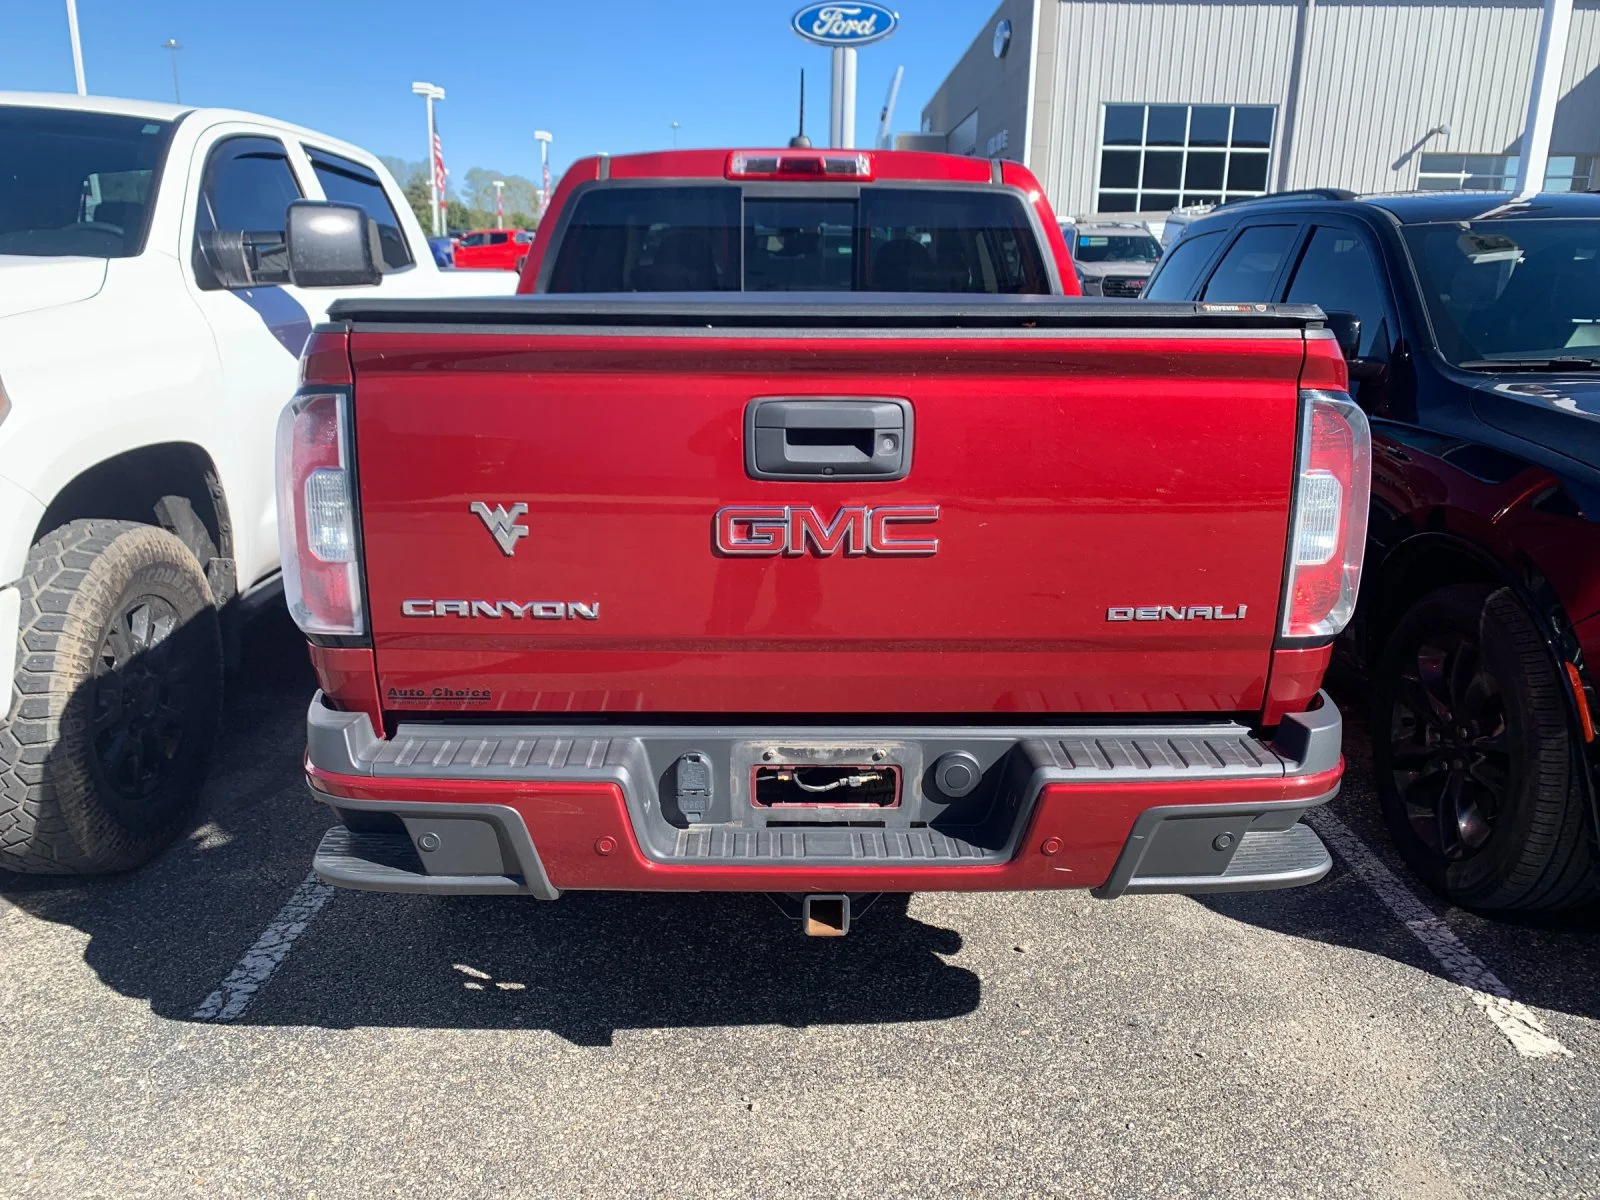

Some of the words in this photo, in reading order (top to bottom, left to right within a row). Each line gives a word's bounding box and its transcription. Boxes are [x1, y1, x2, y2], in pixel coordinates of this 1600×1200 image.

[812, 7, 877, 35] Ford
[714, 505, 940, 556] GMC
[402, 599, 600, 620] CANYON
[1107, 604, 1248, 621] DENALI
[388, 687, 425, 697] Auto
[432, 687, 491, 697] Choice
